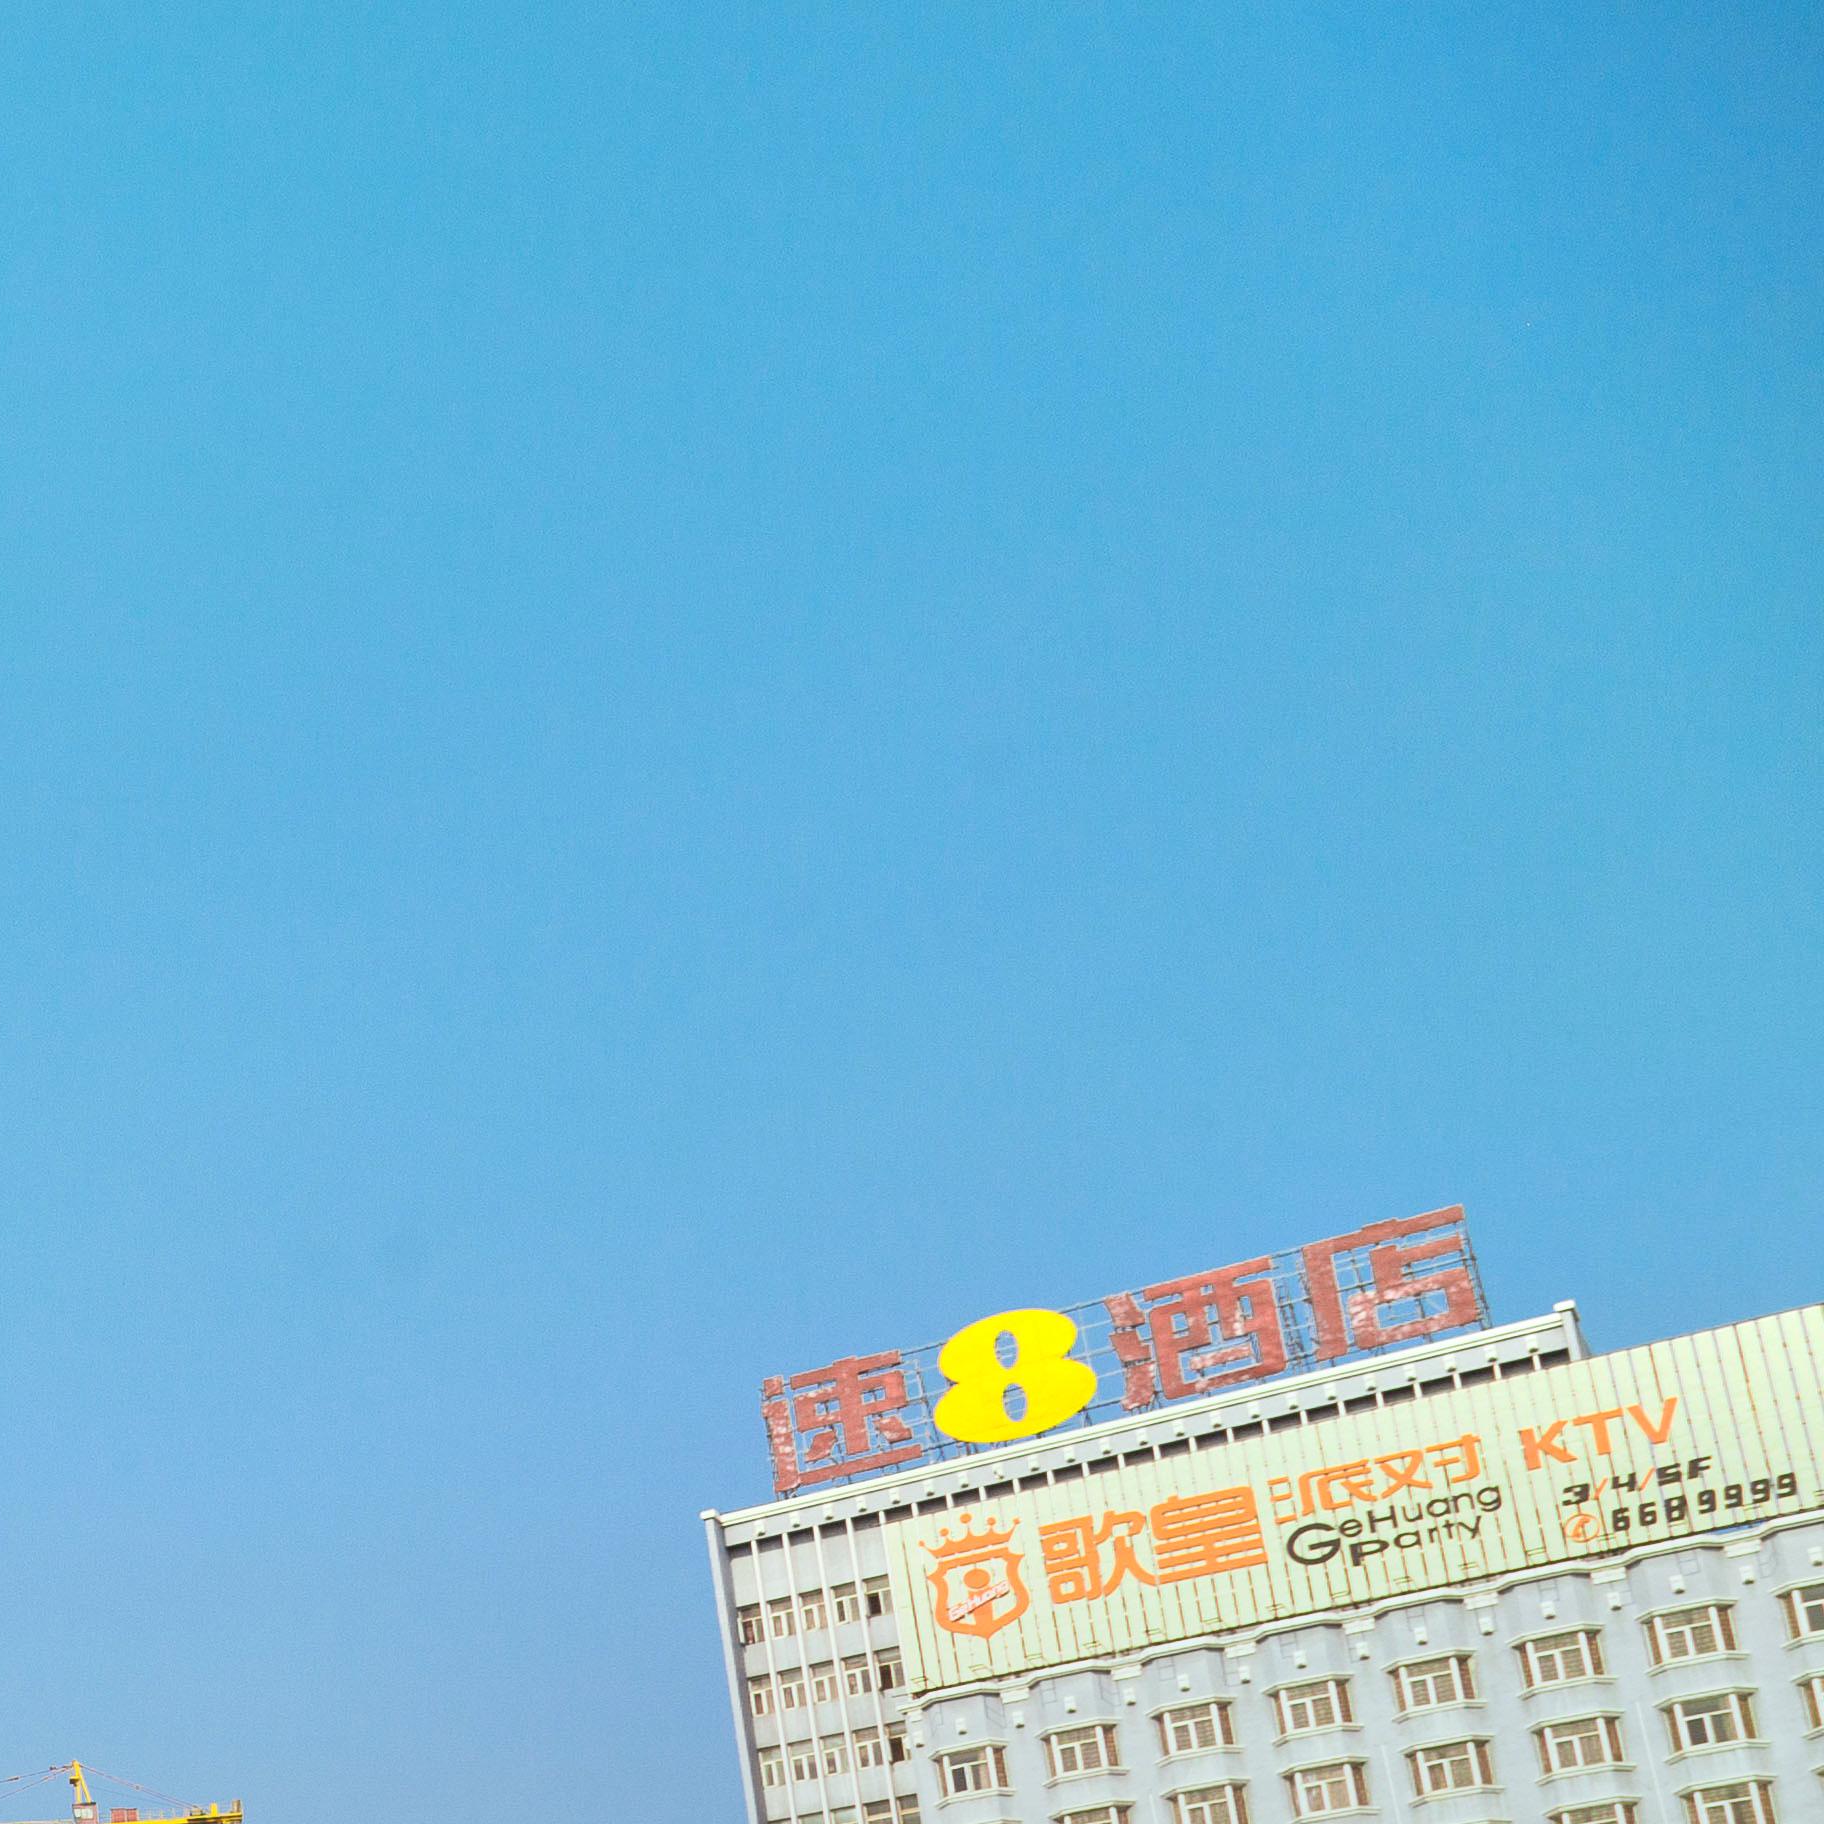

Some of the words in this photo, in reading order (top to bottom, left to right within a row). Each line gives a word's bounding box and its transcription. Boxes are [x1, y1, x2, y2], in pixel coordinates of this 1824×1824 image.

[761, 1204, 1481, 1492] 速8酒店
[1519, 1396, 1678, 1470] KTV
[1561, 1455, 1712, 1506] 3/4/5F
[1611, 1471, 1799, 1533] 6689999
[1287, 1485, 1502, 1566] GeHuang
